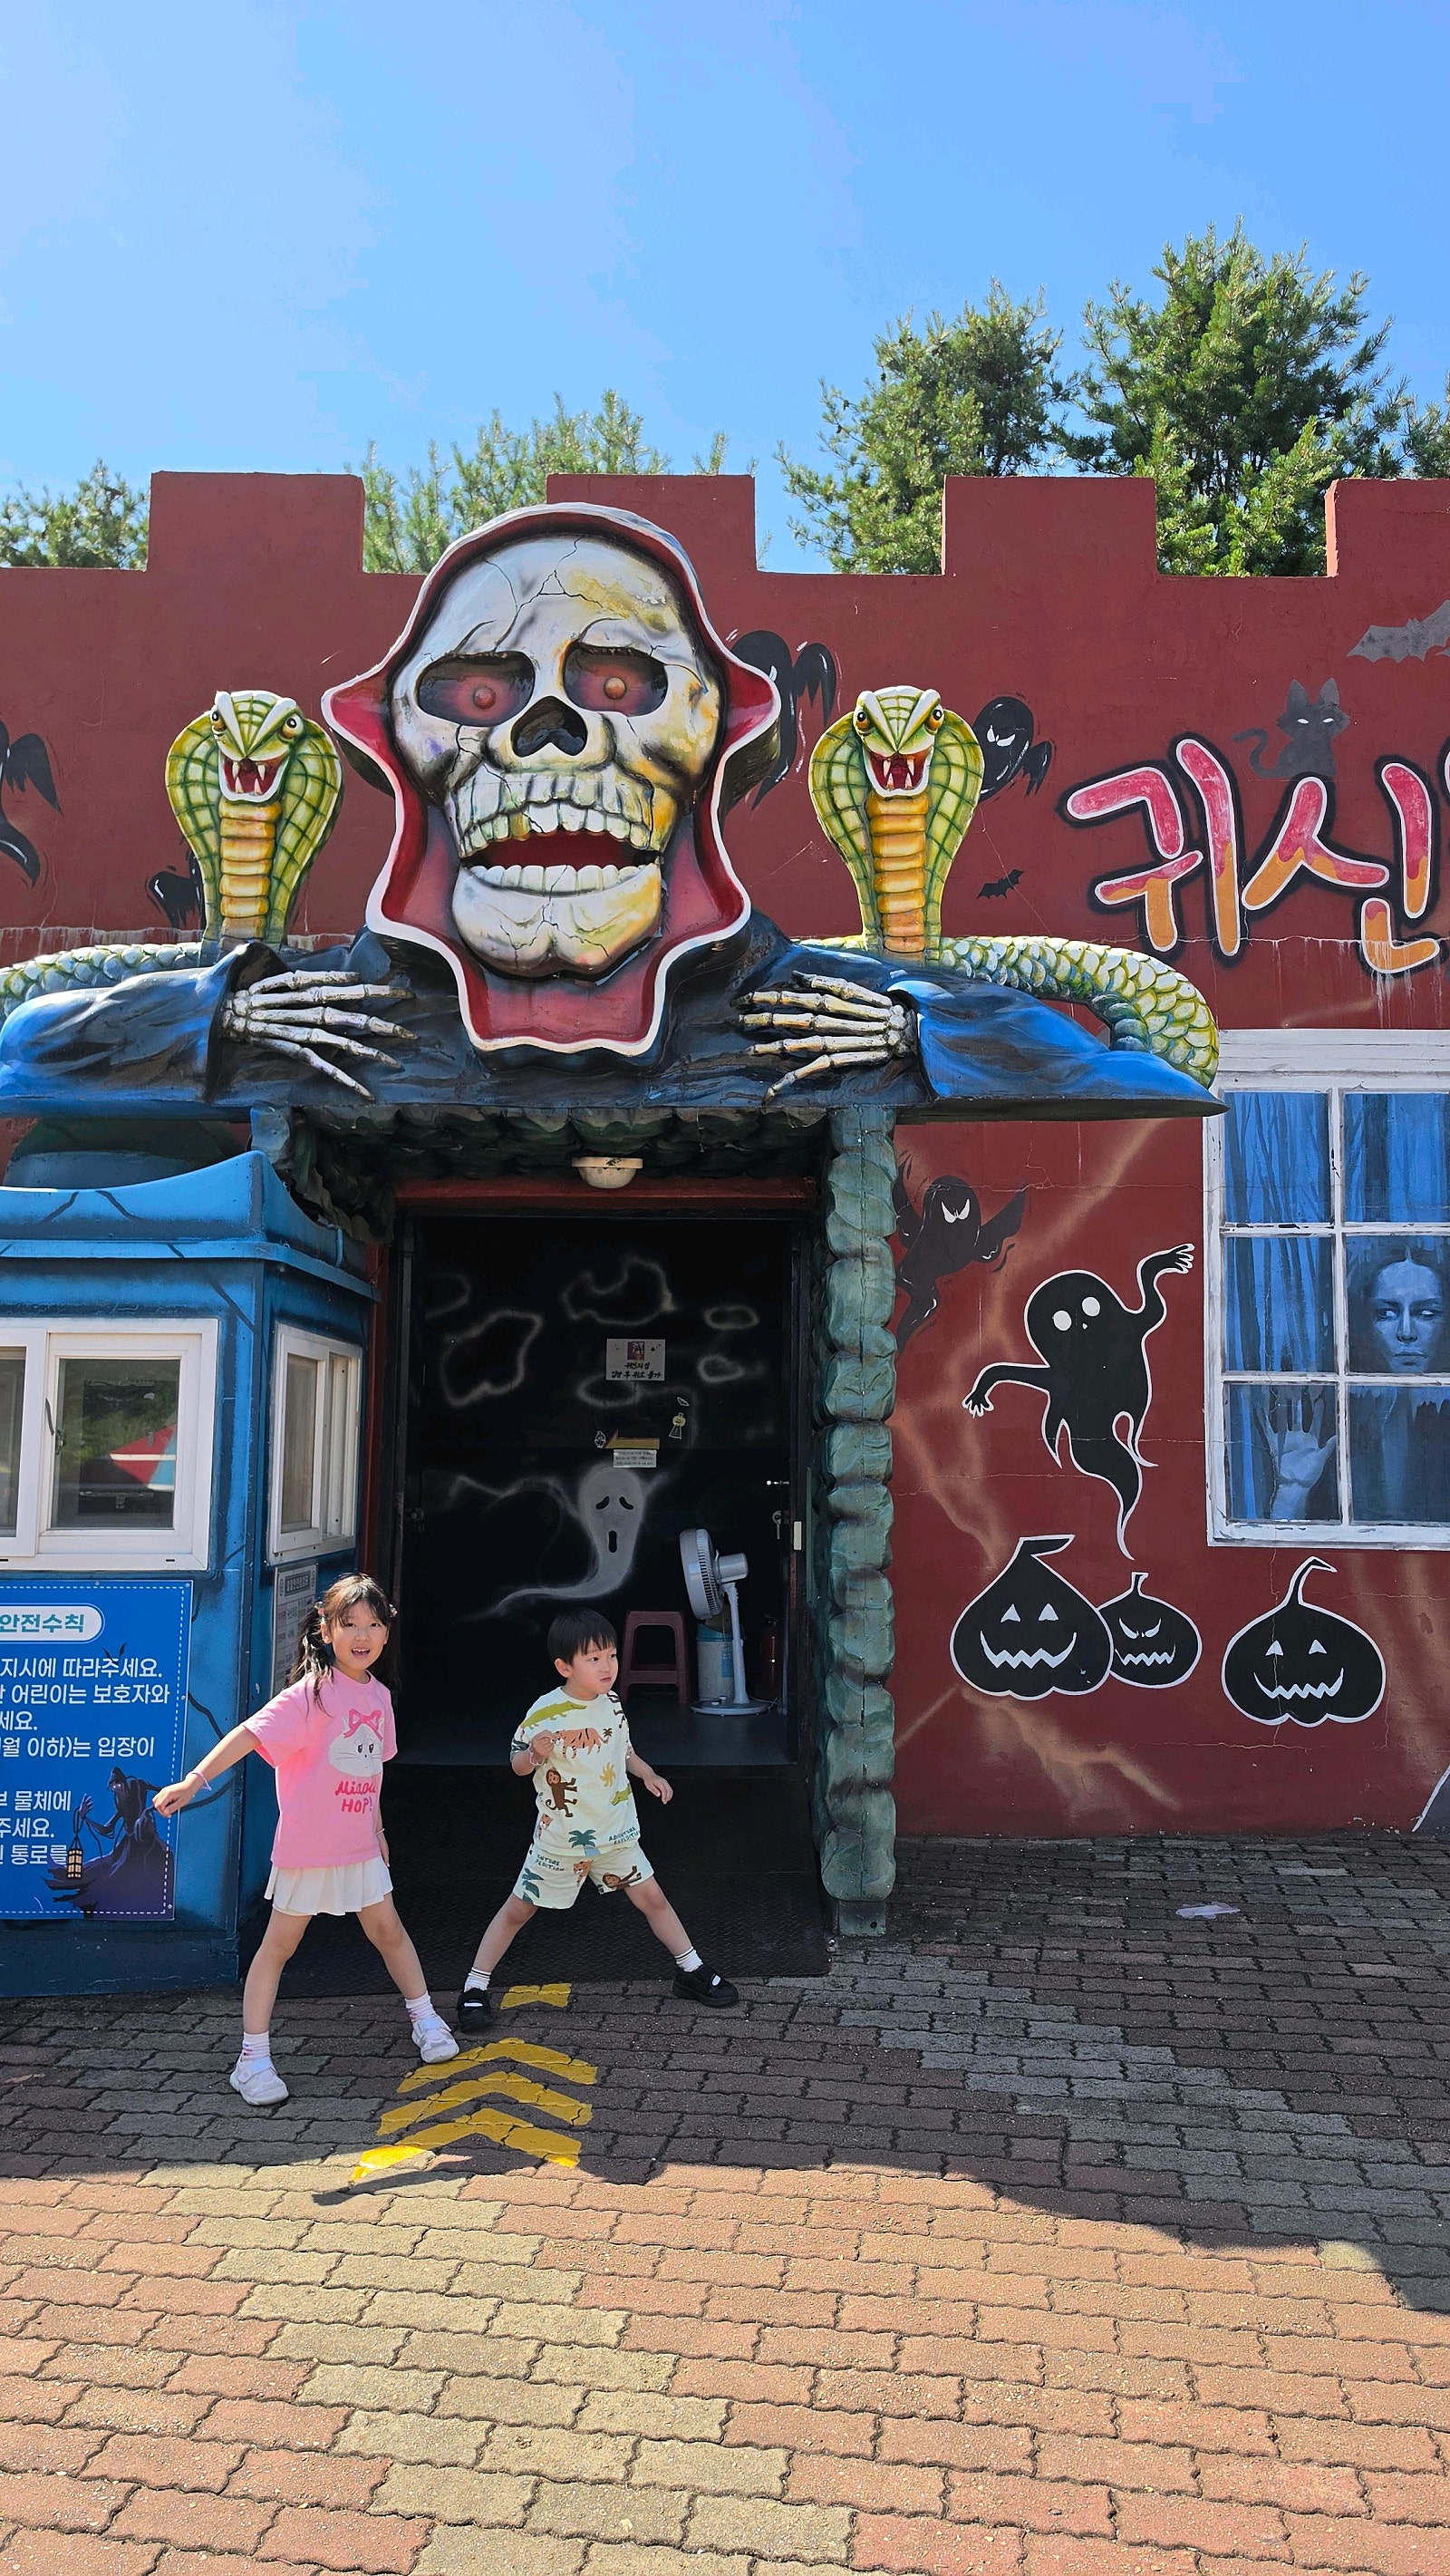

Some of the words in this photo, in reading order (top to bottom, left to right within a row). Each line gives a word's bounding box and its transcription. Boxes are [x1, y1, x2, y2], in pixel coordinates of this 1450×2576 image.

[0, 1613, 84, 1633] 안전수칙
[0, 1658, 56, 1678] 지시에
[63, 1657, 162, 1679] 따라주세요.
[11, 1683, 87, 1705] 어린이는
[92, 1683, 170, 1704] 보호자와
[27, 1736, 91, 1758] 이하)는
[97, 1737, 154, 1757] 입장이
[14, 1790, 72, 1811] 물체에
[341, 1796, 372, 1814] HOP!
[11, 1845, 68, 1865] 통로를
